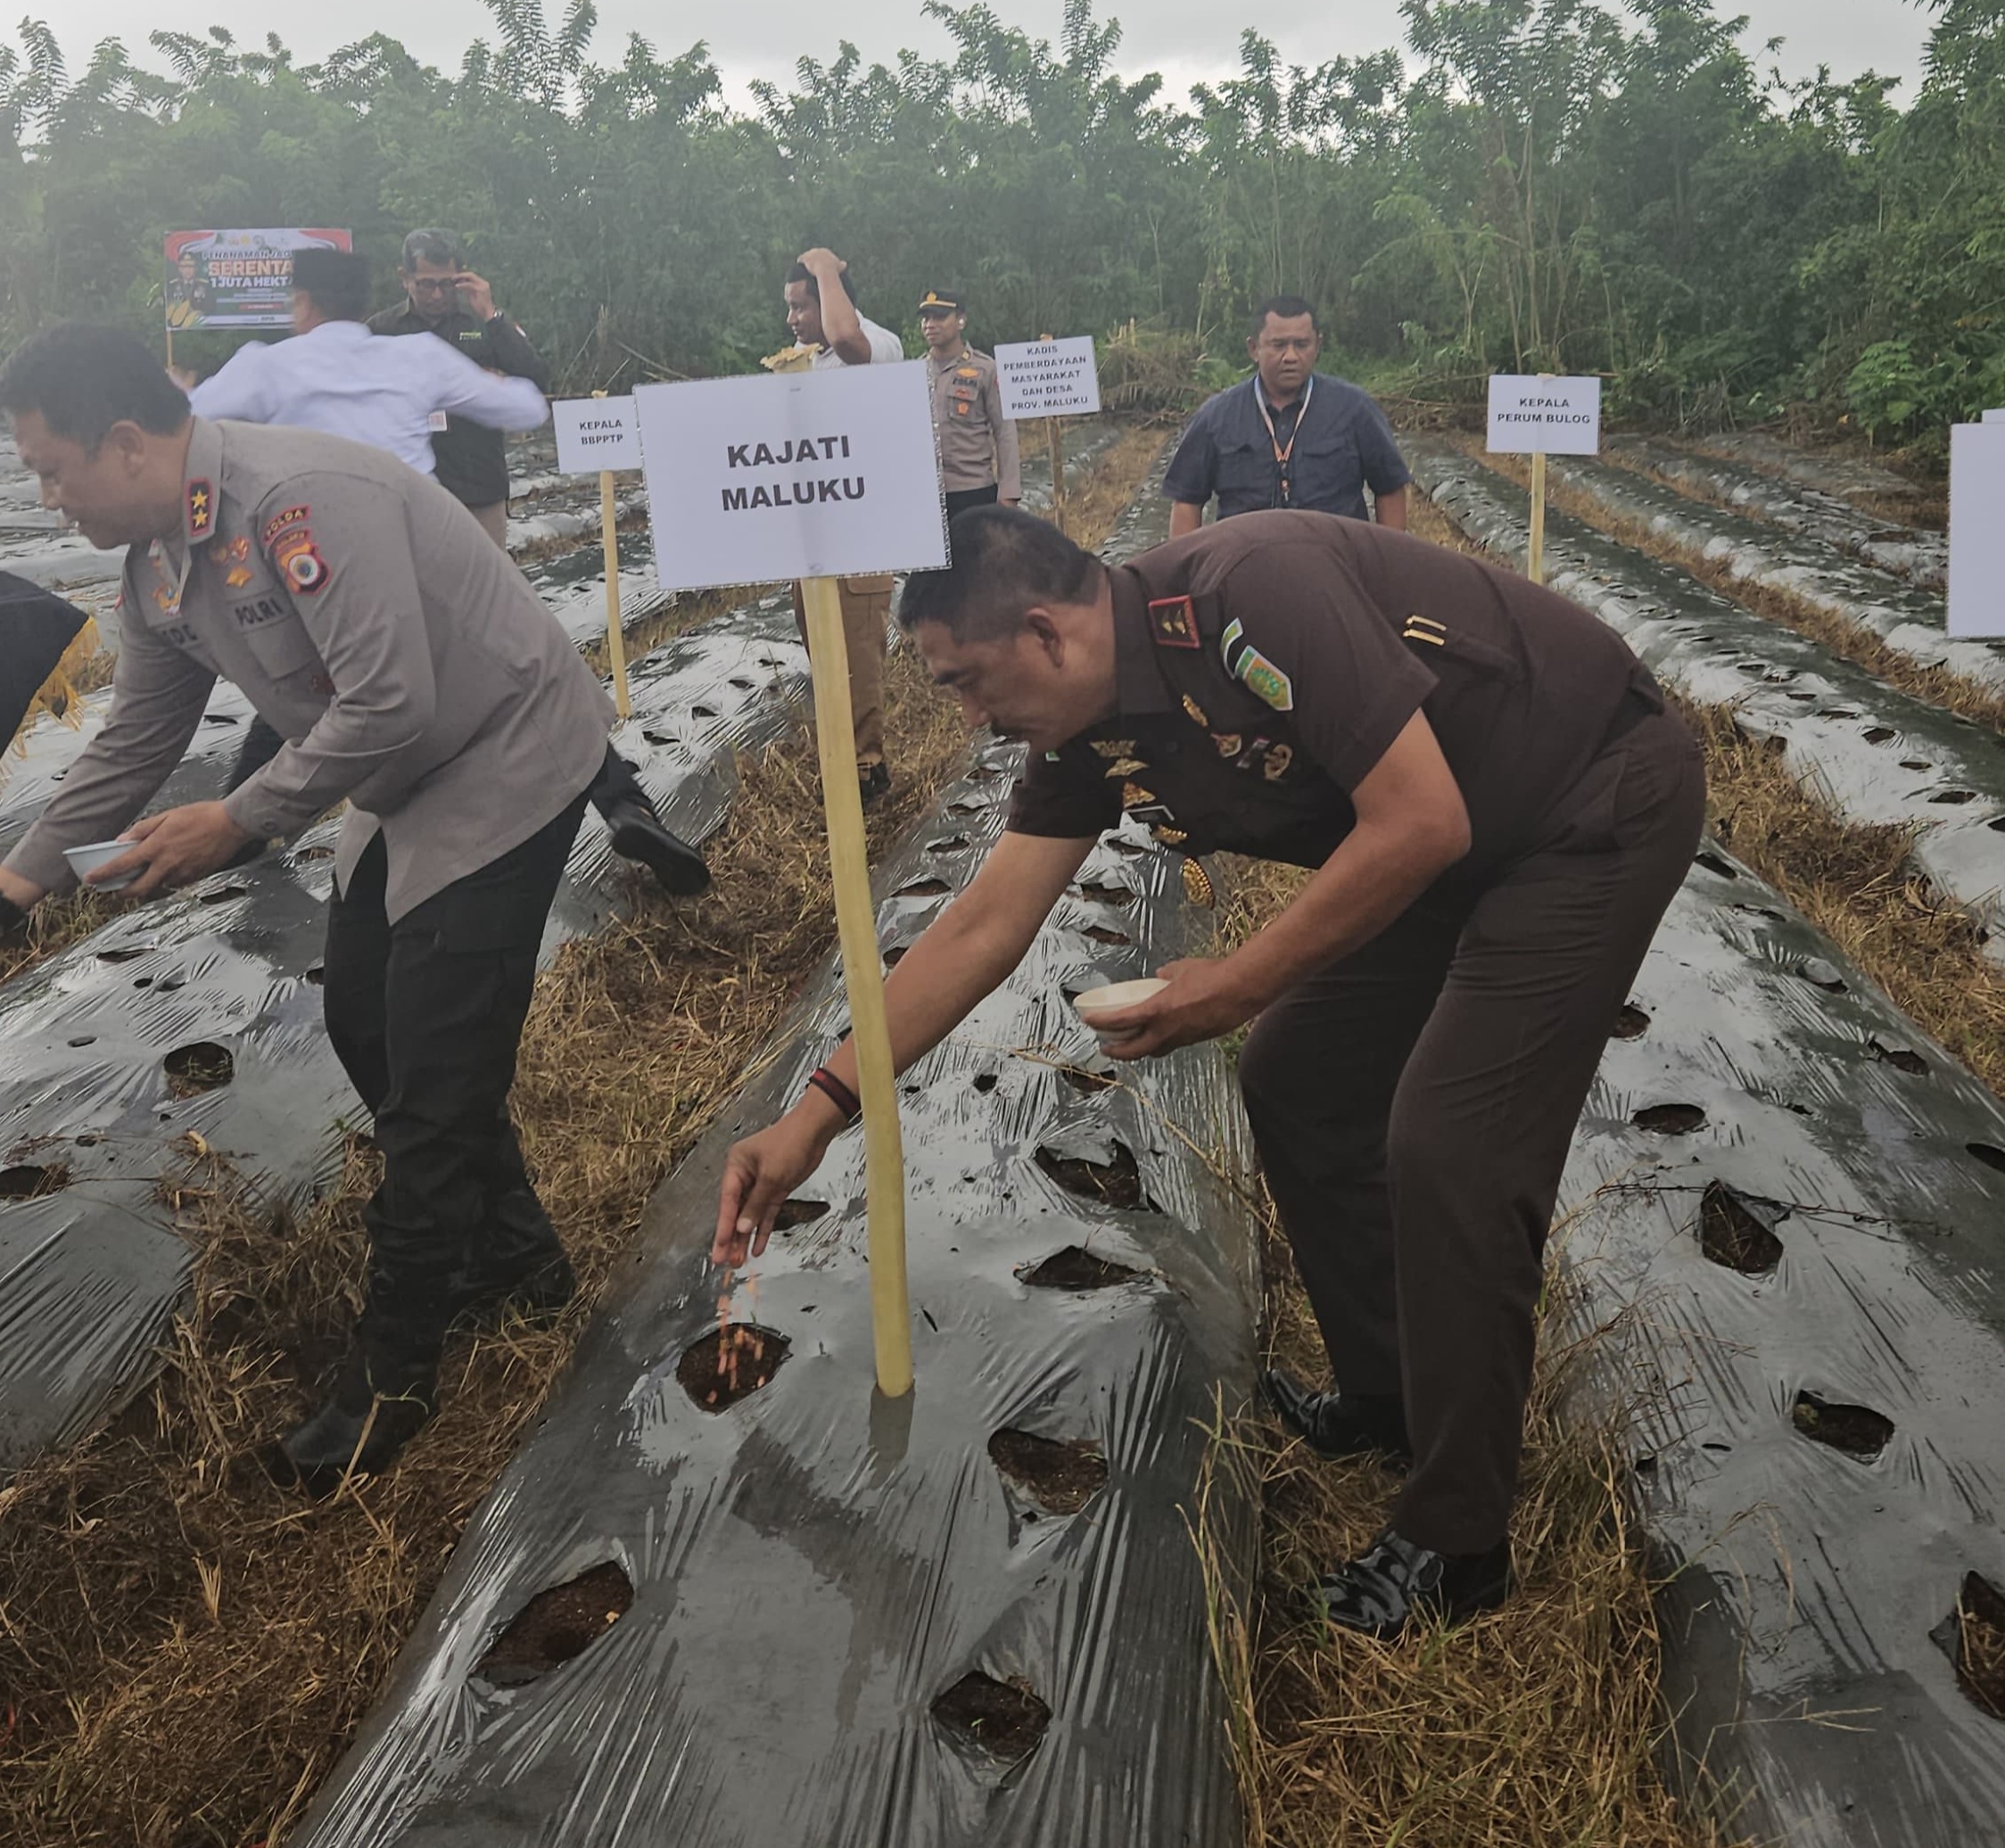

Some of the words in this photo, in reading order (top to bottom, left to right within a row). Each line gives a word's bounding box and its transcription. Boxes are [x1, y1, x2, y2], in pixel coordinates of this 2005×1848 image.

[209, 260, 293, 276] SERENTA
[210, 277, 217, 288] 1
[219, 277, 252, 287] JUTA
[253, 276, 293, 287] HEKT
[1027, 345, 1058, 356] KADIS
[1003, 356, 1086, 371] PEMBERDAYAAN
[1011, 370, 1081, 384] MASYARAKAT
[1022, 387, 1043, 396] DAN
[1045, 384, 1073, 394] DESA
[1011, 401, 1041, 410] PROV.
[1044, 396, 1088, 408] MALUKU
[1519, 398, 1570, 408] KEPALA
[580, 419, 623, 430] KEPALA
[1498, 413, 1542, 423] PERUM
[1546, 415, 1590, 424] BULOG
[582, 434, 623, 445] BBPPTP
[727, 435, 850, 468] KAJATI
[722, 476, 865, 511] MALUKU
